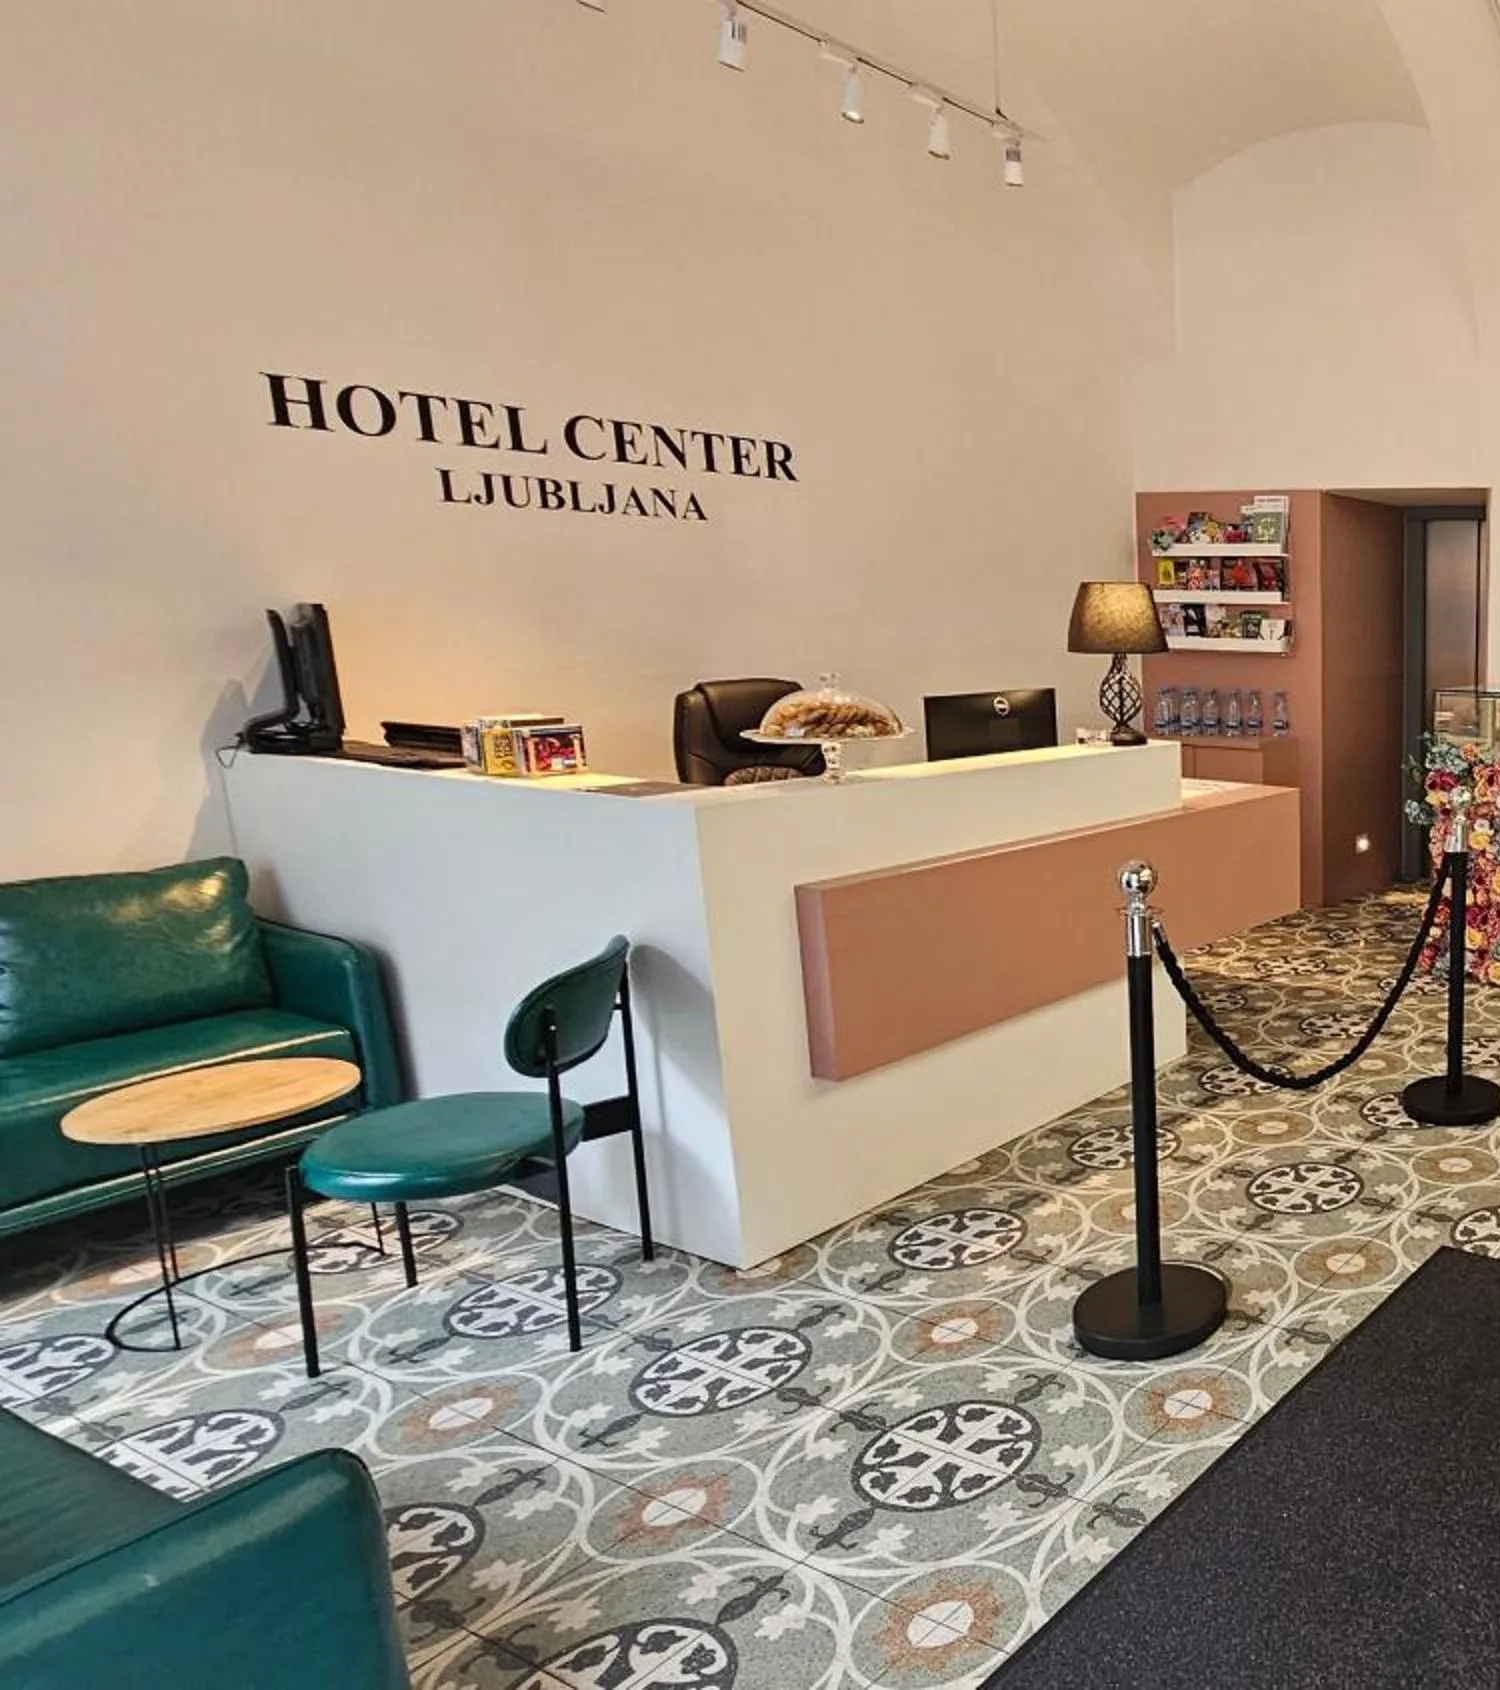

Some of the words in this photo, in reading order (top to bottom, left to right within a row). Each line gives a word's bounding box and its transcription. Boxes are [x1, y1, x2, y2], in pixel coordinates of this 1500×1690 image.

[259, 371, 549, 455] HOTEL
[563, 414, 800, 482] CENTER
[435, 468, 709, 522] LJUBLJANA
